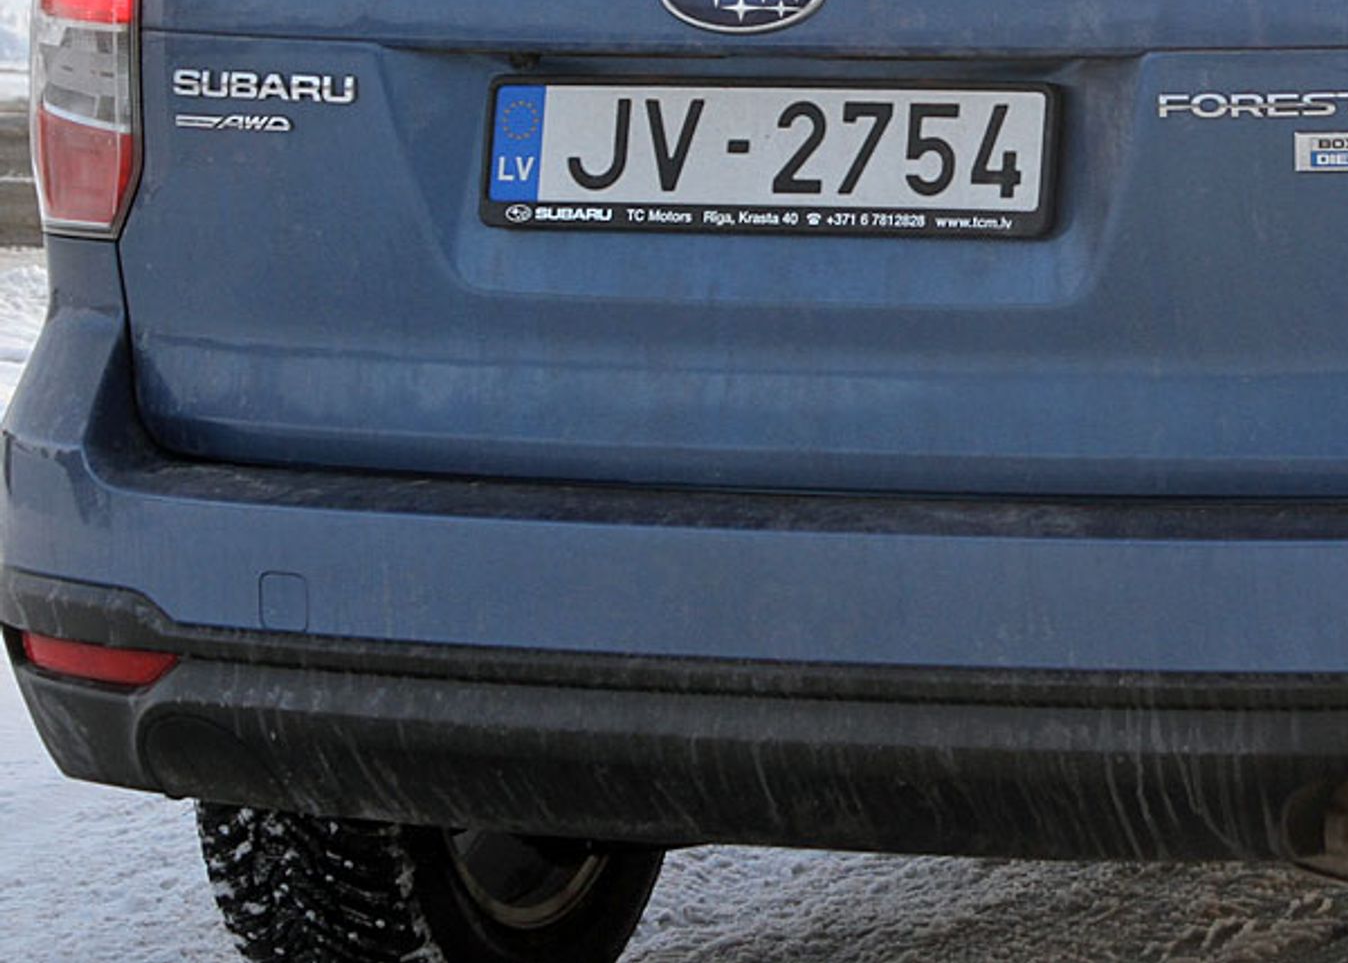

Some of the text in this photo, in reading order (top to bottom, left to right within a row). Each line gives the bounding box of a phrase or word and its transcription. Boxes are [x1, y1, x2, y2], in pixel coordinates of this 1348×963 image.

[172, 68, 355, 104] SUBARU
[216, 114, 292, 132] AWD
[497, 156, 535, 182] LV
[534, 206, 613, 222] SUBARU
[626, 208, 645, 222] TC
[648, 209, 692, 223] Motors
[738, 211, 779, 225] Krasta
[782, 211, 799, 225] 40
[827, 212, 856, 225] +371
